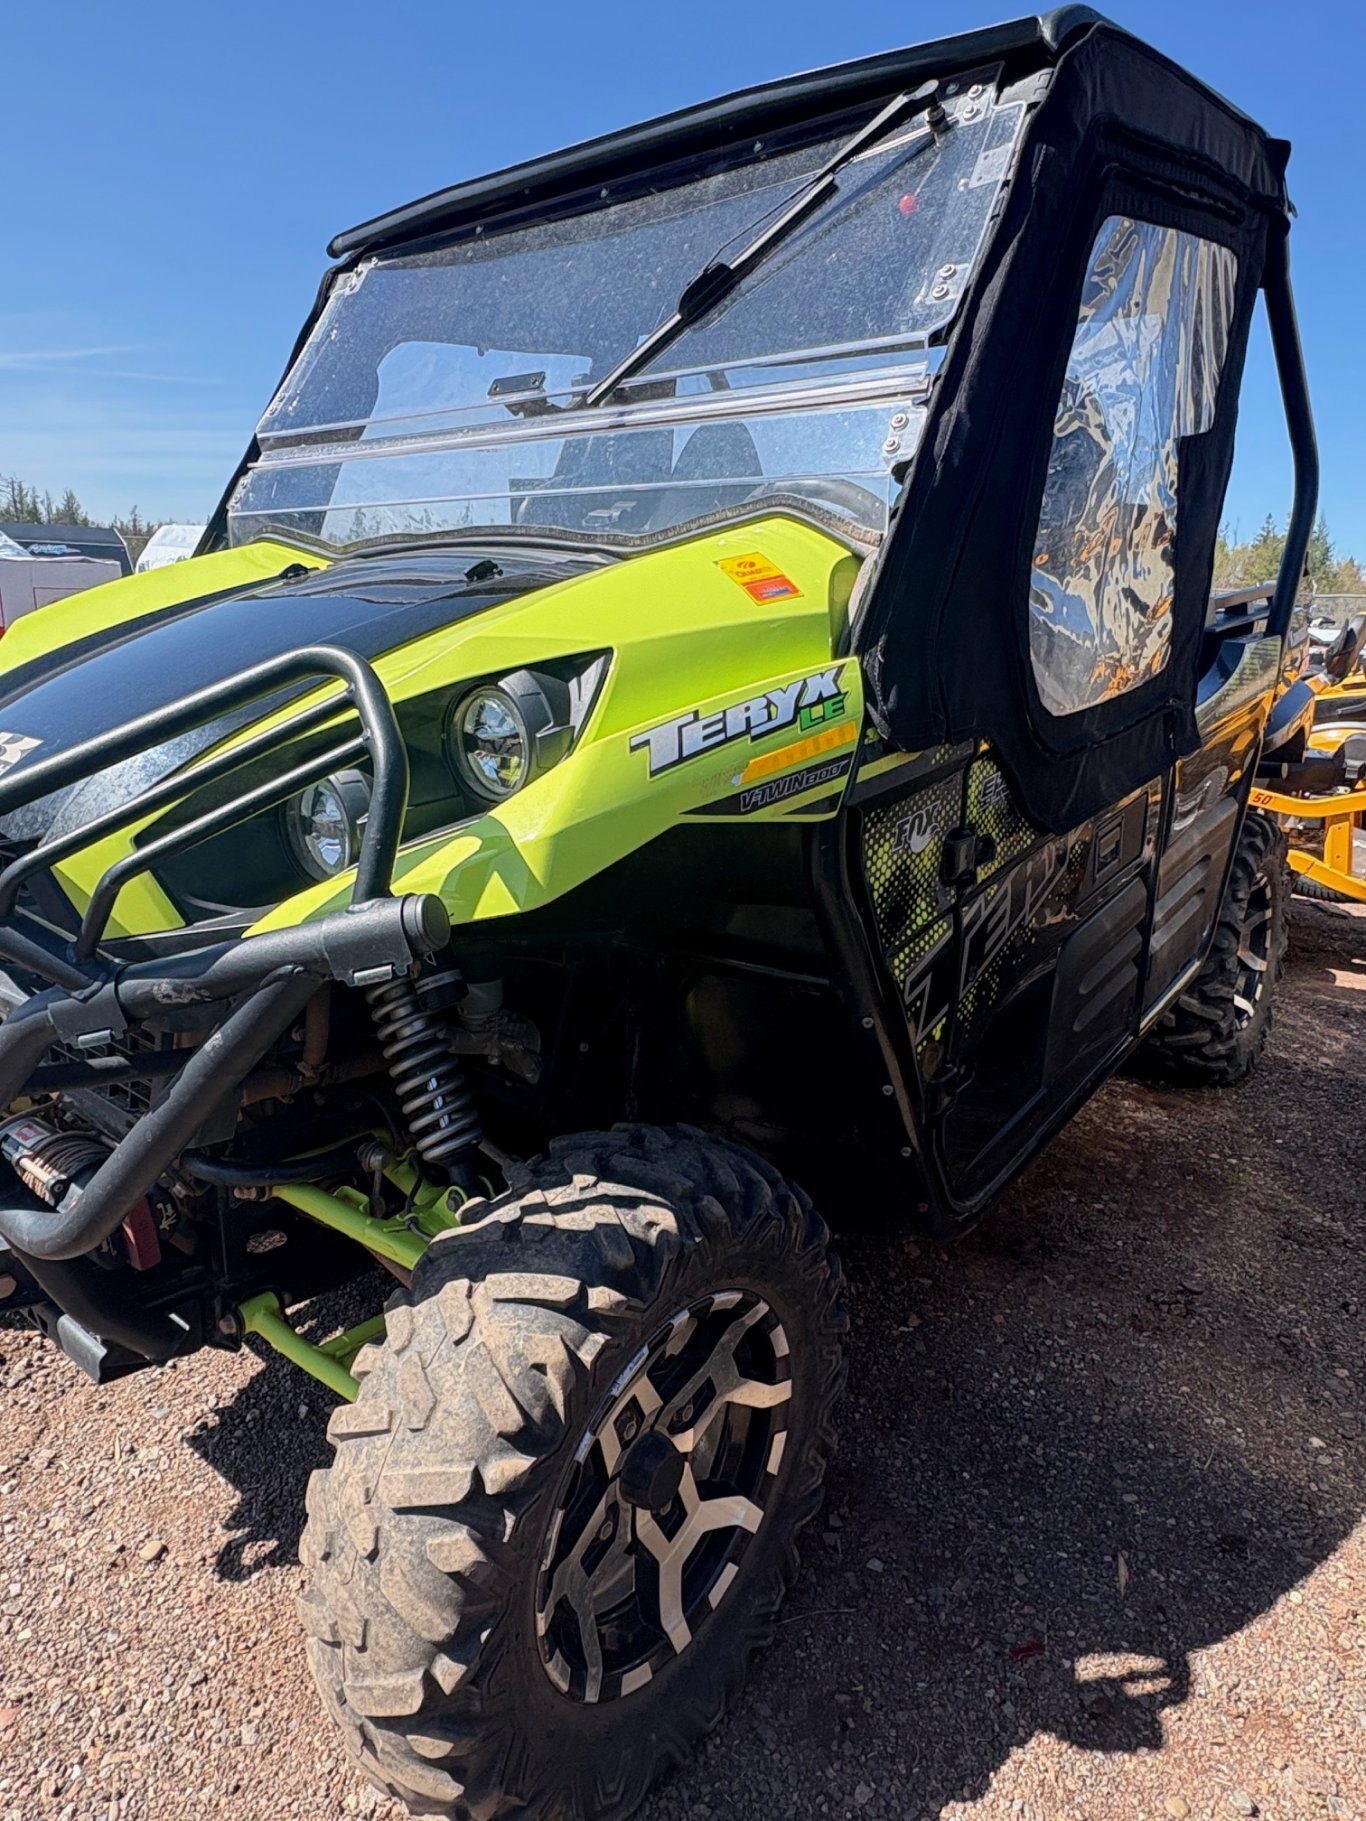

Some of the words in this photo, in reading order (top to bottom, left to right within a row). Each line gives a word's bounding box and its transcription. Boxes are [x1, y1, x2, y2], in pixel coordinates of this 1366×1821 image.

[629, 663, 846, 778] TERYX
[800, 691, 849, 732] LE
[892, 799, 942, 853] FOX
